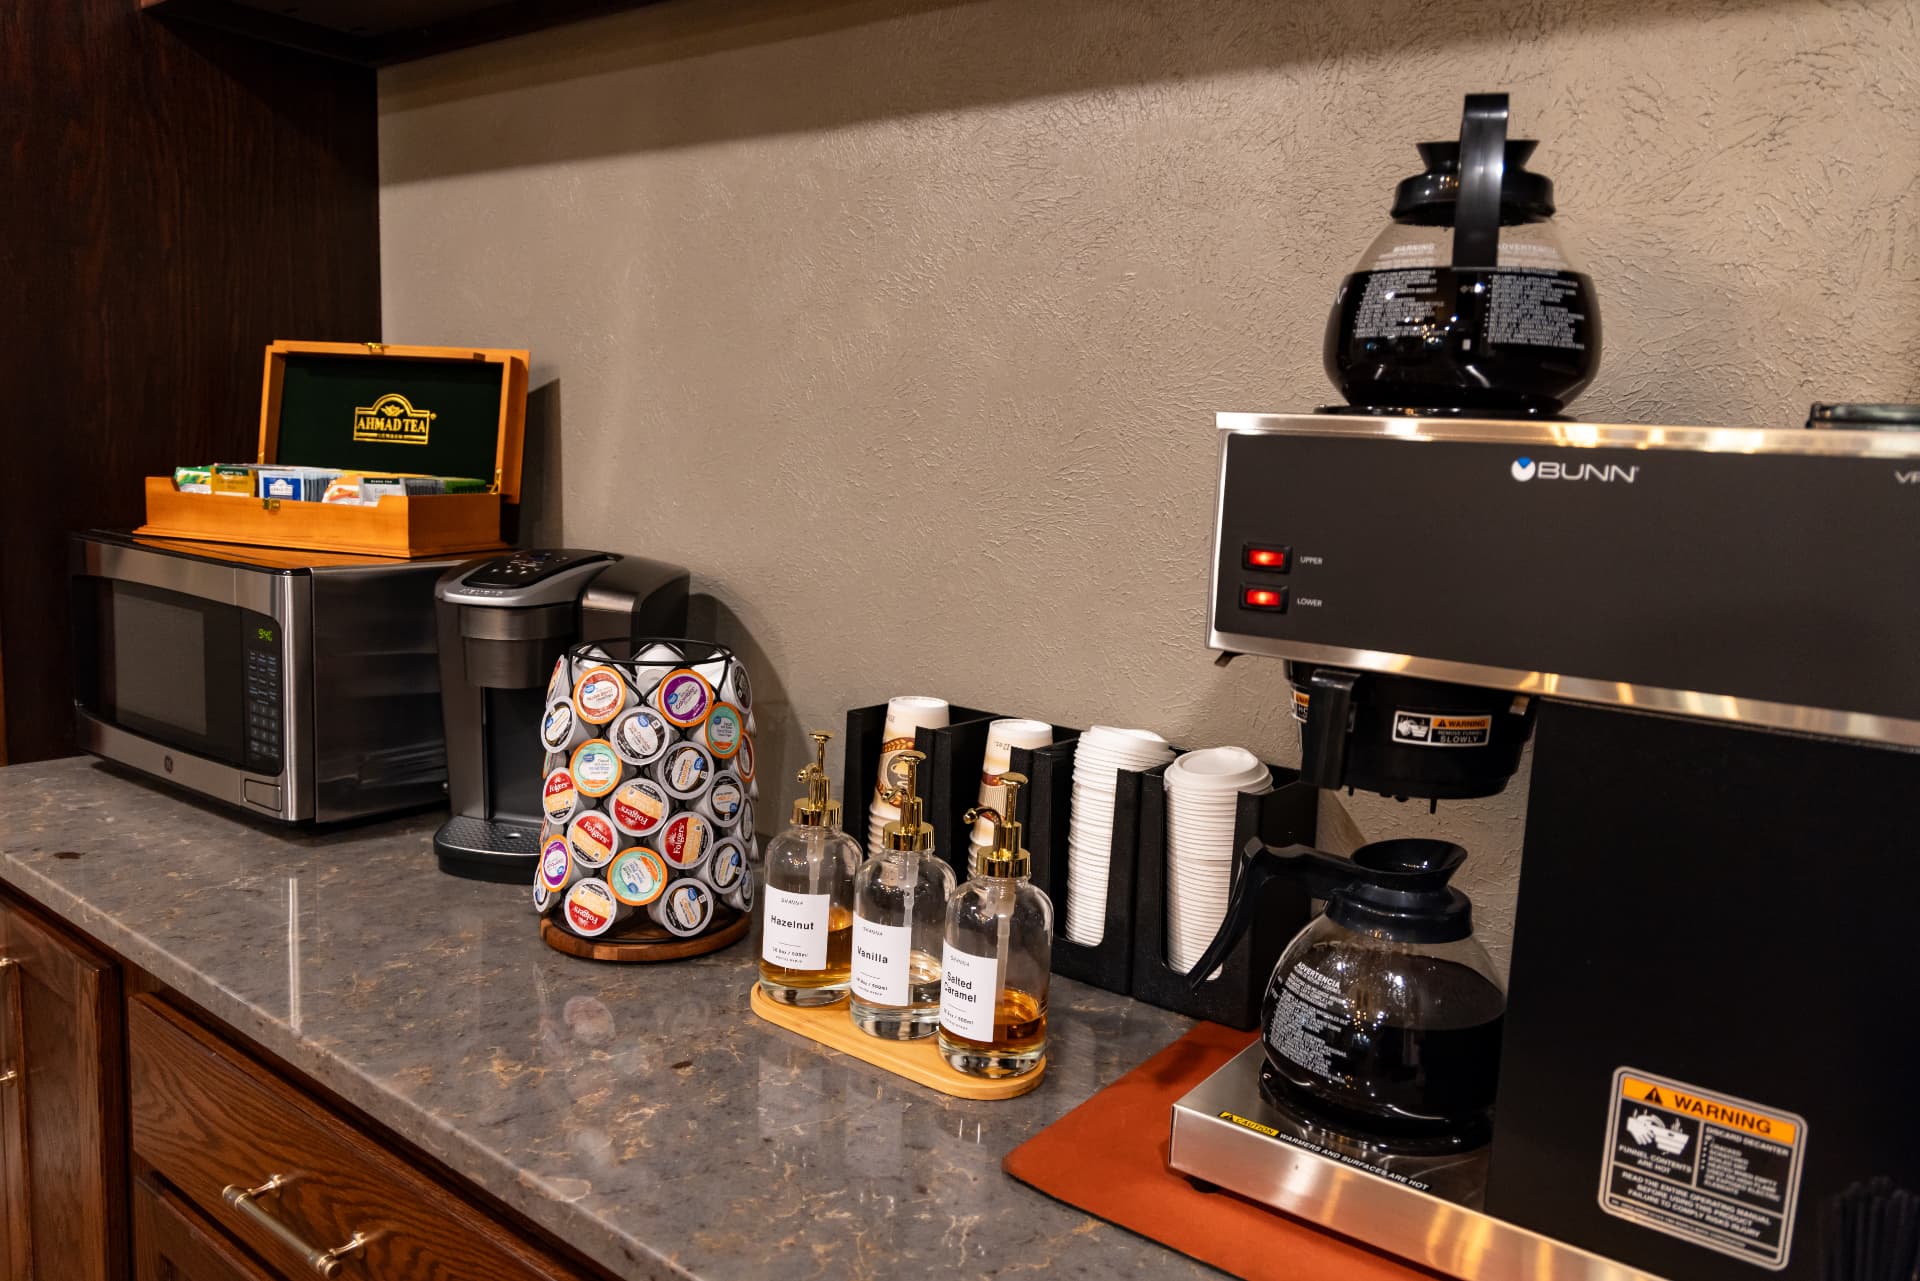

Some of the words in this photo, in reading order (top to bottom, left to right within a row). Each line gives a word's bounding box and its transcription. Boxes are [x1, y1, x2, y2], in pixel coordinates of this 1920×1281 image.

[358, 417, 402, 431] AHMAD
[403, 418, 426, 432] TEA
[1537, 462, 1635, 483] BUNN
[1300, 556, 1323, 565] UPPER
[1297, 598, 1322, 607] LOWER
[1448, 719, 1486, 729] WARNING
[1440, 735, 1479, 743] SLOWLY
[550, 783, 567, 792] Folgers
[620, 806, 648, 825] Folgers
[584, 821, 609, 843] Folgers
[673, 823, 685, 854] Folgers
[573, 906, 598, 924] Folgers
[771, 915, 814, 930] Hazelnut
[857, 945, 888, 964] Vanilla
[947, 971, 972, 989] Salted
[1297, 961, 1340, 988] ADVERTENCIA
[945, 981, 977, 1003] Caramel
[1674, 1094, 1772, 1134] WARNING
[1236, 1118, 1274, 1136] CAUTION
[1279, 1132, 1322, 1152] WARMERS
[1322, 1148, 1341, 1160] AND
[1341, 1155, 1388, 1176] SURFACES
[1387, 1171, 1408, 1183] ARE
[1408, 1179, 1429, 1191] HOT
[1744, 1137, 1787, 1157] DECANTER
[1619, 1144, 1647, 1159] FUNNEL
[1649, 1153, 1691, 1173] CONTENTS
[1638, 1158, 1652, 1169] ARE
[1655, 1163, 1670, 1174] HOT
[1622, 1170, 1642, 1183] READ
[1645, 1178, 1658, 1188] THE
[1660, 1183, 1687, 1198] ENTIRE
[1690, 1192, 1733, 1213] OPERATING
[1736, 1207, 1770, 1224] MANUAL
[1637, 1184, 1667, 1199] BEFORE
[1670, 1194, 1693, 1207] USING
[1695, 1202, 1712, 1213] THIS
[1714, 1208, 1752, 1226] PRODUCT
[1628, 1188, 1660, 1205] FAILURE
[1662, 1199, 1670, 1208] TO
[1672, 1203, 1703, 1219] COMPLY
[1705, 1213, 1729, 1228] RISKS
